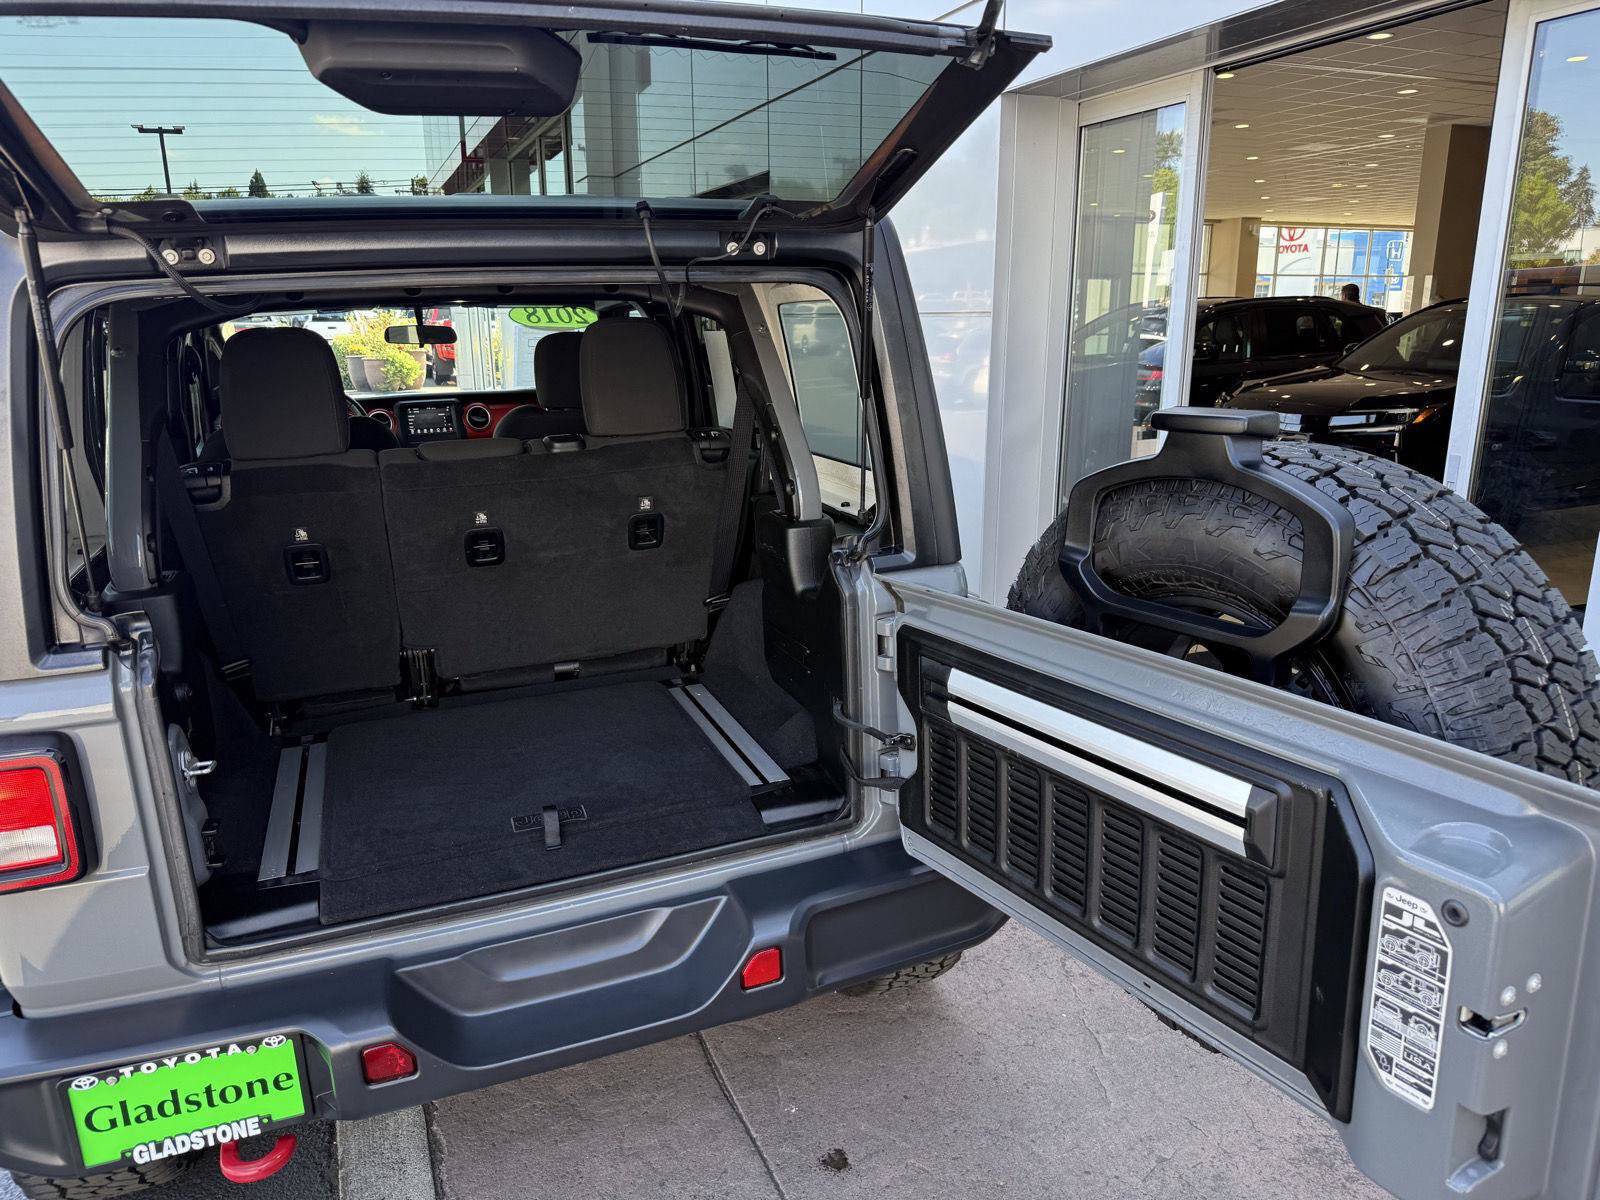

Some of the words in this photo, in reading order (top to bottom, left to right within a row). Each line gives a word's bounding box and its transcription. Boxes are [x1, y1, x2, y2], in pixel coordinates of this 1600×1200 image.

[1279, 244, 1309, 254] OYOTA
[1396, 895, 1418, 909] Jeep
[1384, 911, 1441, 938] JL
[119, 1044, 242, 1079] TOYOTA
[84, 1072, 293, 1133] Gladstone
[132, 1117, 261, 1166] GLADSTONE
